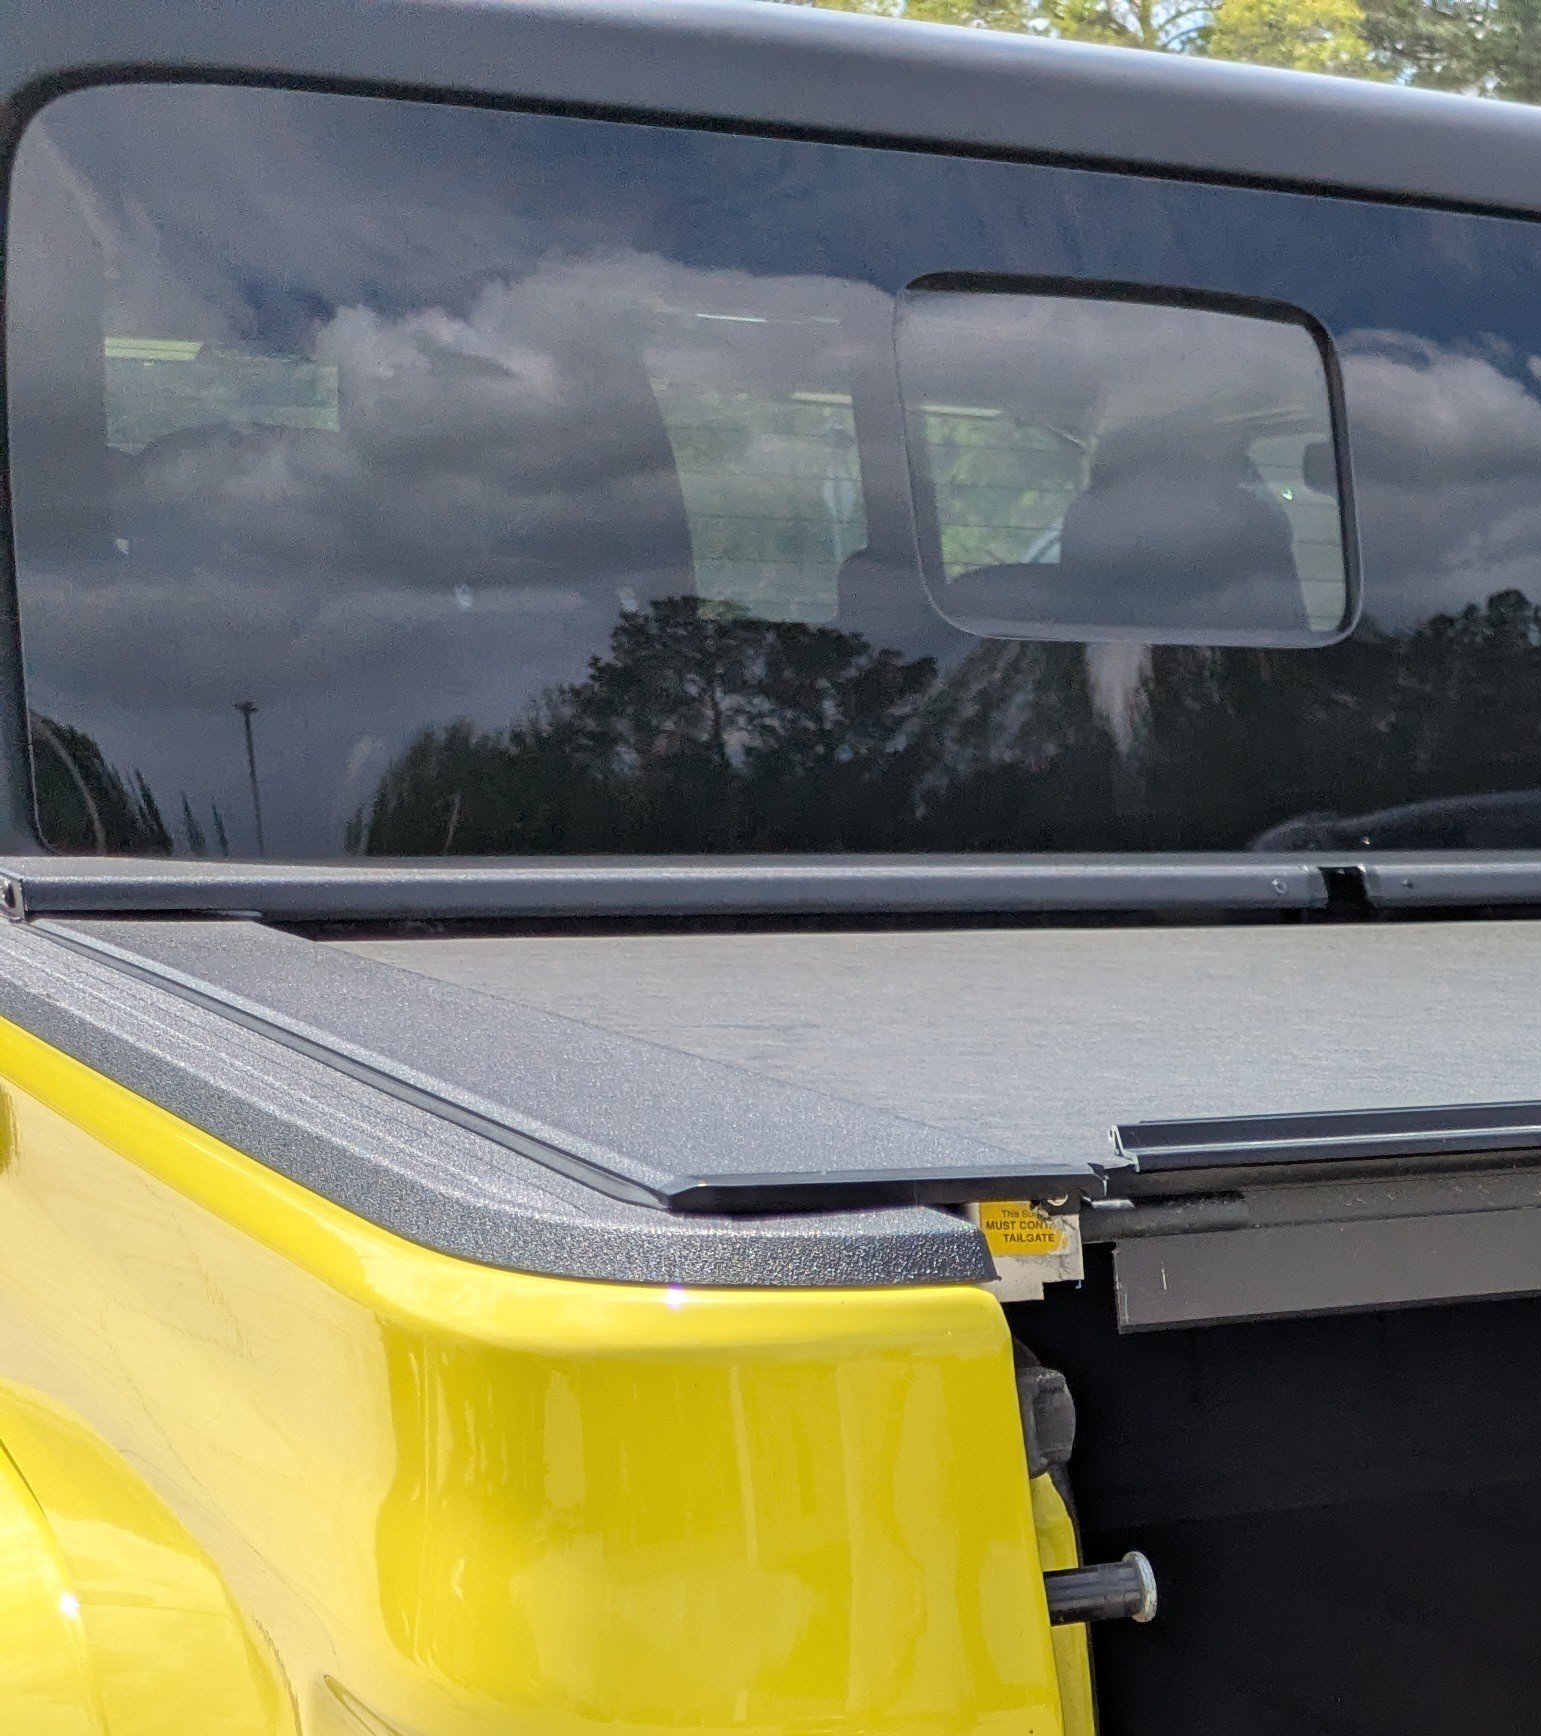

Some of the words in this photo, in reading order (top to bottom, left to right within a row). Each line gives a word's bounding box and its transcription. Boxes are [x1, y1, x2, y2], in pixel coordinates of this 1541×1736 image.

[1001, 1210, 1019, 1219] This
[986, 1220, 1016, 1230] MUST
[1003, 1233, 1055, 1243] TAILGATE
